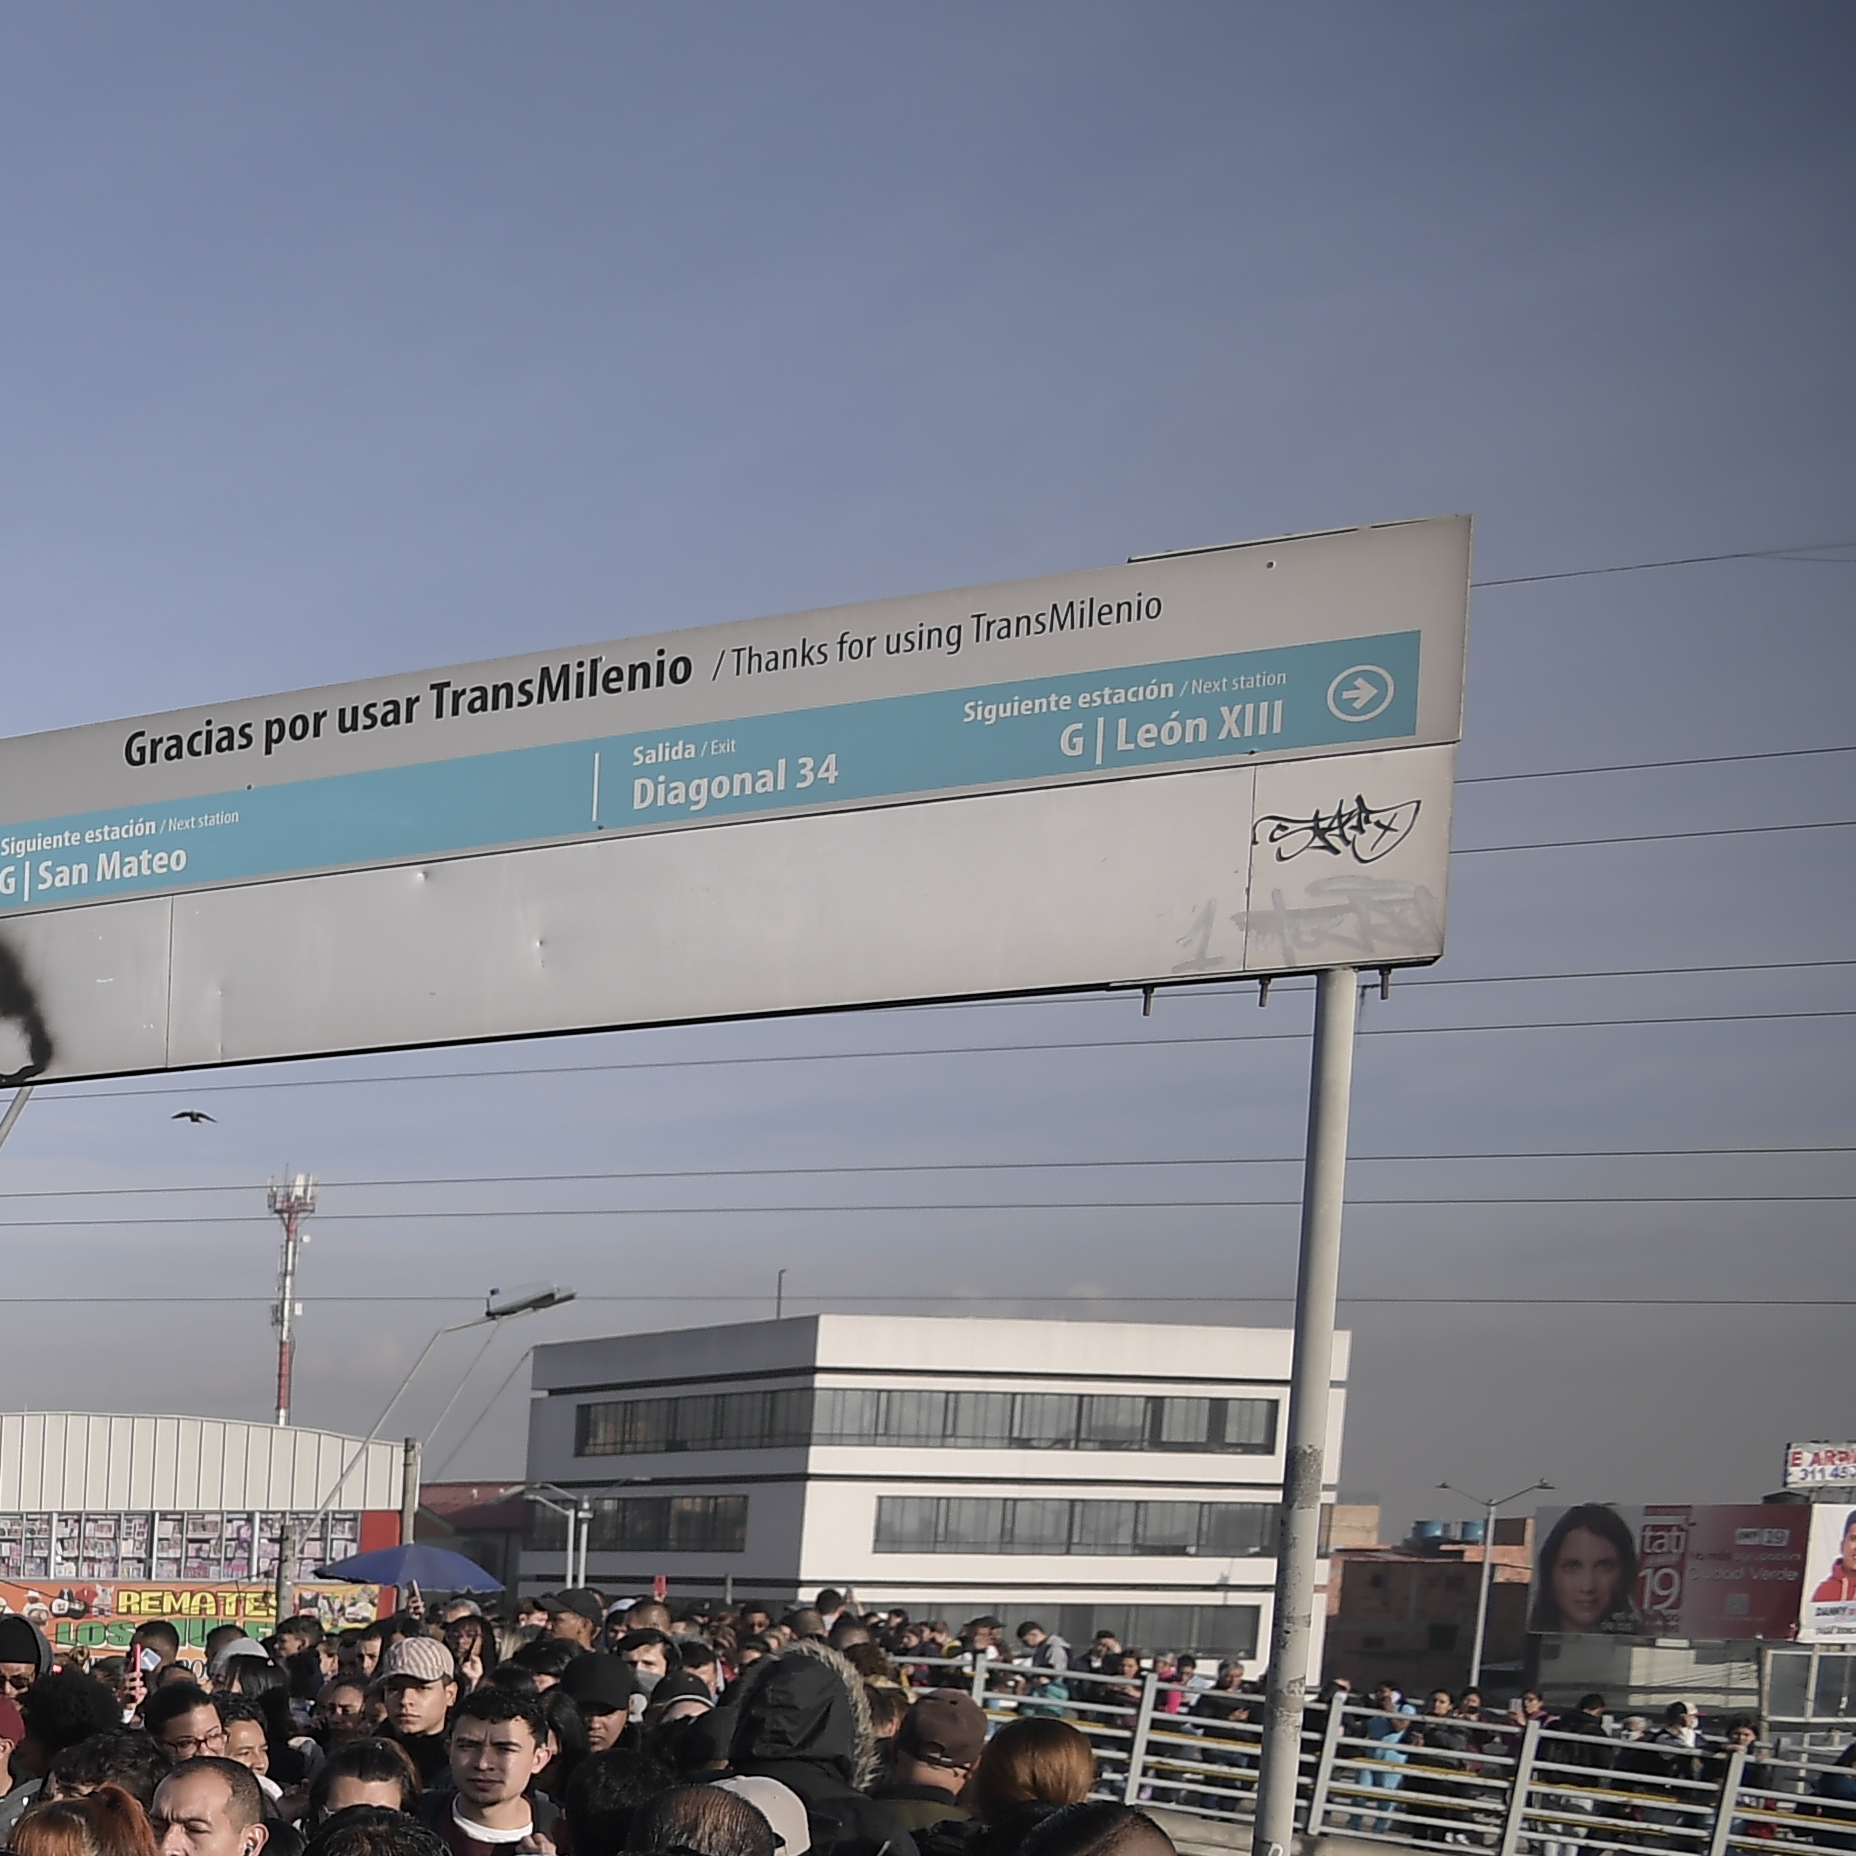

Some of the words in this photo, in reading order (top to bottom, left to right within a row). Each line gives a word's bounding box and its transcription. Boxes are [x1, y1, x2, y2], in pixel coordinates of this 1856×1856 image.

[123, 718, 255, 769] Gracias
[263, 707, 328, 756] por
[337, 692, 421, 735] usar
[428, 647, 694, 722] TransMilenio
[731, 637, 829, 678] Thanks
[836, 631, 878, 664] for
[884, 621, 964, 656] using
[970, 590, 1164, 645] TransMilenio
[963, 694, 1073, 727] Siguiente
[1077, 678, 1175, 710] estación
[1231, 669, 1287, 691] station
[631, 739, 697, 767] Salida
[710, 738, 737, 756] Exit
[1059, 721, 1084, 757] G
[1116, 709, 1208, 752] León
[1217, 699, 1285, 741] XIII
[632, 757, 787, 812] Diagonal
[795, 752, 840, 790] 34
[0, 829, 81, 859] Siguiente
[84, 817, 157, 845] estación
[197, 810, 240, 829] station
[37, 859, 89, 892] San
[95, 848, 188, 884] Mateo
[1638, 1566, 1683, 1611] 19
[56, 1619, 136, 1649] LOS
